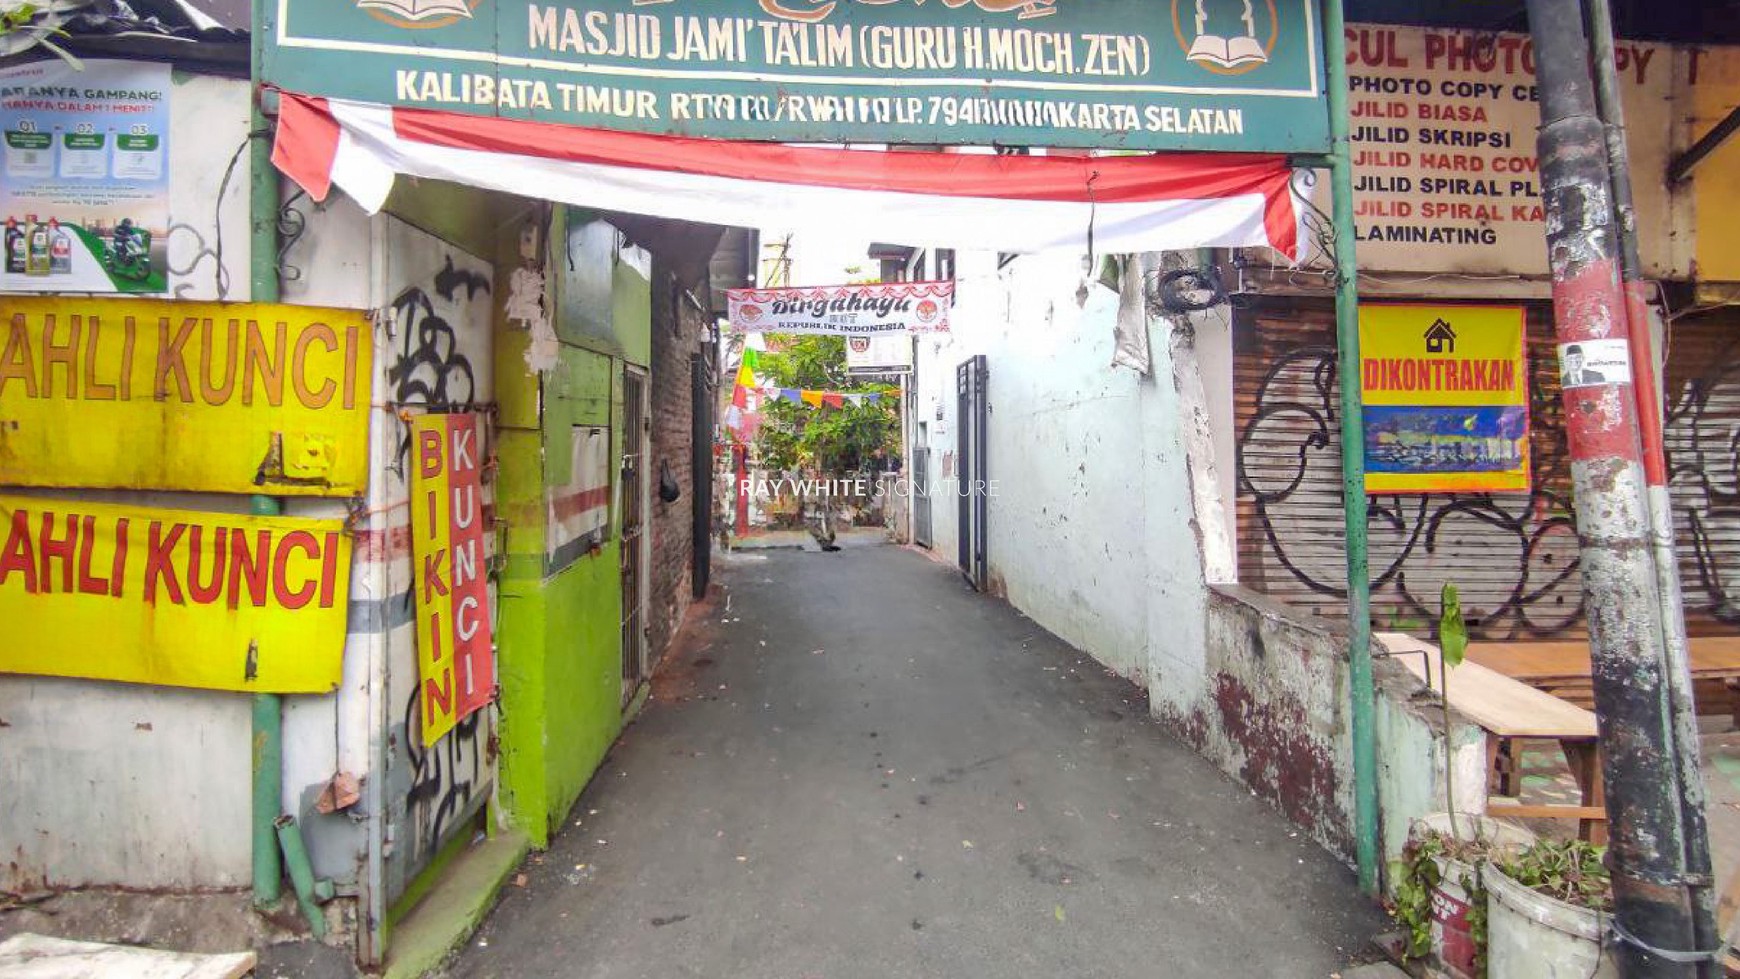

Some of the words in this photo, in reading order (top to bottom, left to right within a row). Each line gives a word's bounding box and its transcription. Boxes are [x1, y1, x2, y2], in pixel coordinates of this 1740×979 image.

[528, 4, 660, 60] MASJID
[1349, 75, 1432, 96] PHOTO
[1440, 80, 1503, 100] COPY
[396, 69, 552, 111] KALIBATA
[557, 82, 660, 120] TIMUR
[1145, 104, 1244, 135] SELATAN
[1350, 101, 1408, 119] JILID
[1418, 104, 1488, 122] BIASA
[1351, 126, 1409, 144] JILID
[1418, 128, 1511, 148] SKRIPSI
[1353, 151, 1411, 168] JILID
[1420, 154, 1484, 173] HARD
[1354, 176, 1412, 193] JILID
[1420, 178, 1503, 196] SPIRAL
[1355, 200, 1412, 217] JILID
[1421, 202, 1504, 221] SPIRAL
[1354, 225, 1497, 245] LAMINATING
[778, 321, 836, 330] REPUBLIK
[839, 322, 906, 333] INDONESIA
[0, 313, 136, 402] AHLI
[153, 316, 359, 411] KUNCI
[1363, 358, 1515, 391] DIKONTRAKAN
[0, 509, 130, 599] AHLI
[144, 520, 340, 611] KUNCI
[452, 429, 479, 696] KUNCI
[419, 430, 457, 728] BIKIN
